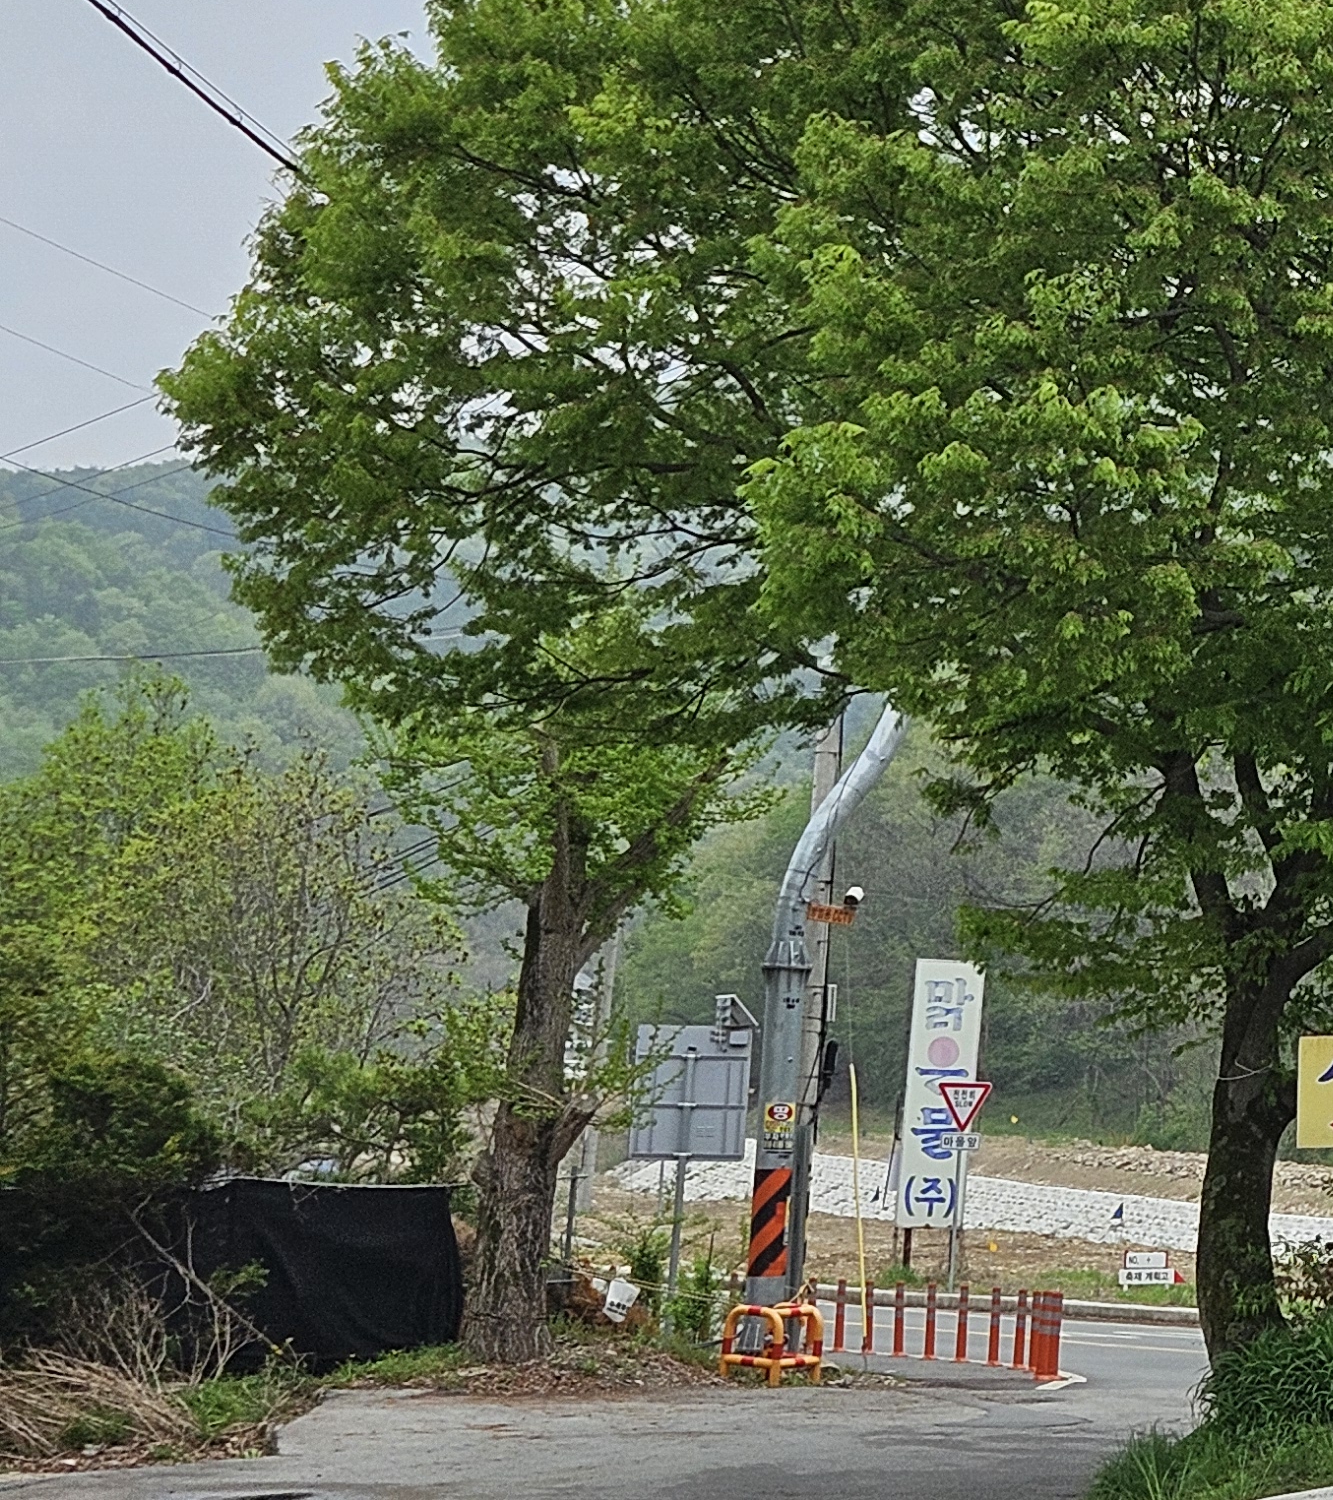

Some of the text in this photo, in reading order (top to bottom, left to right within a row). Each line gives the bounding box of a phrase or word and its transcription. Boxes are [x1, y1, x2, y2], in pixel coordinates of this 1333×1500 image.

[954, 1100, 974, 1108] SLOW
[943, 1135, 978, 1148] 마을앞
[904, 1174, 957, 1219] (주)
